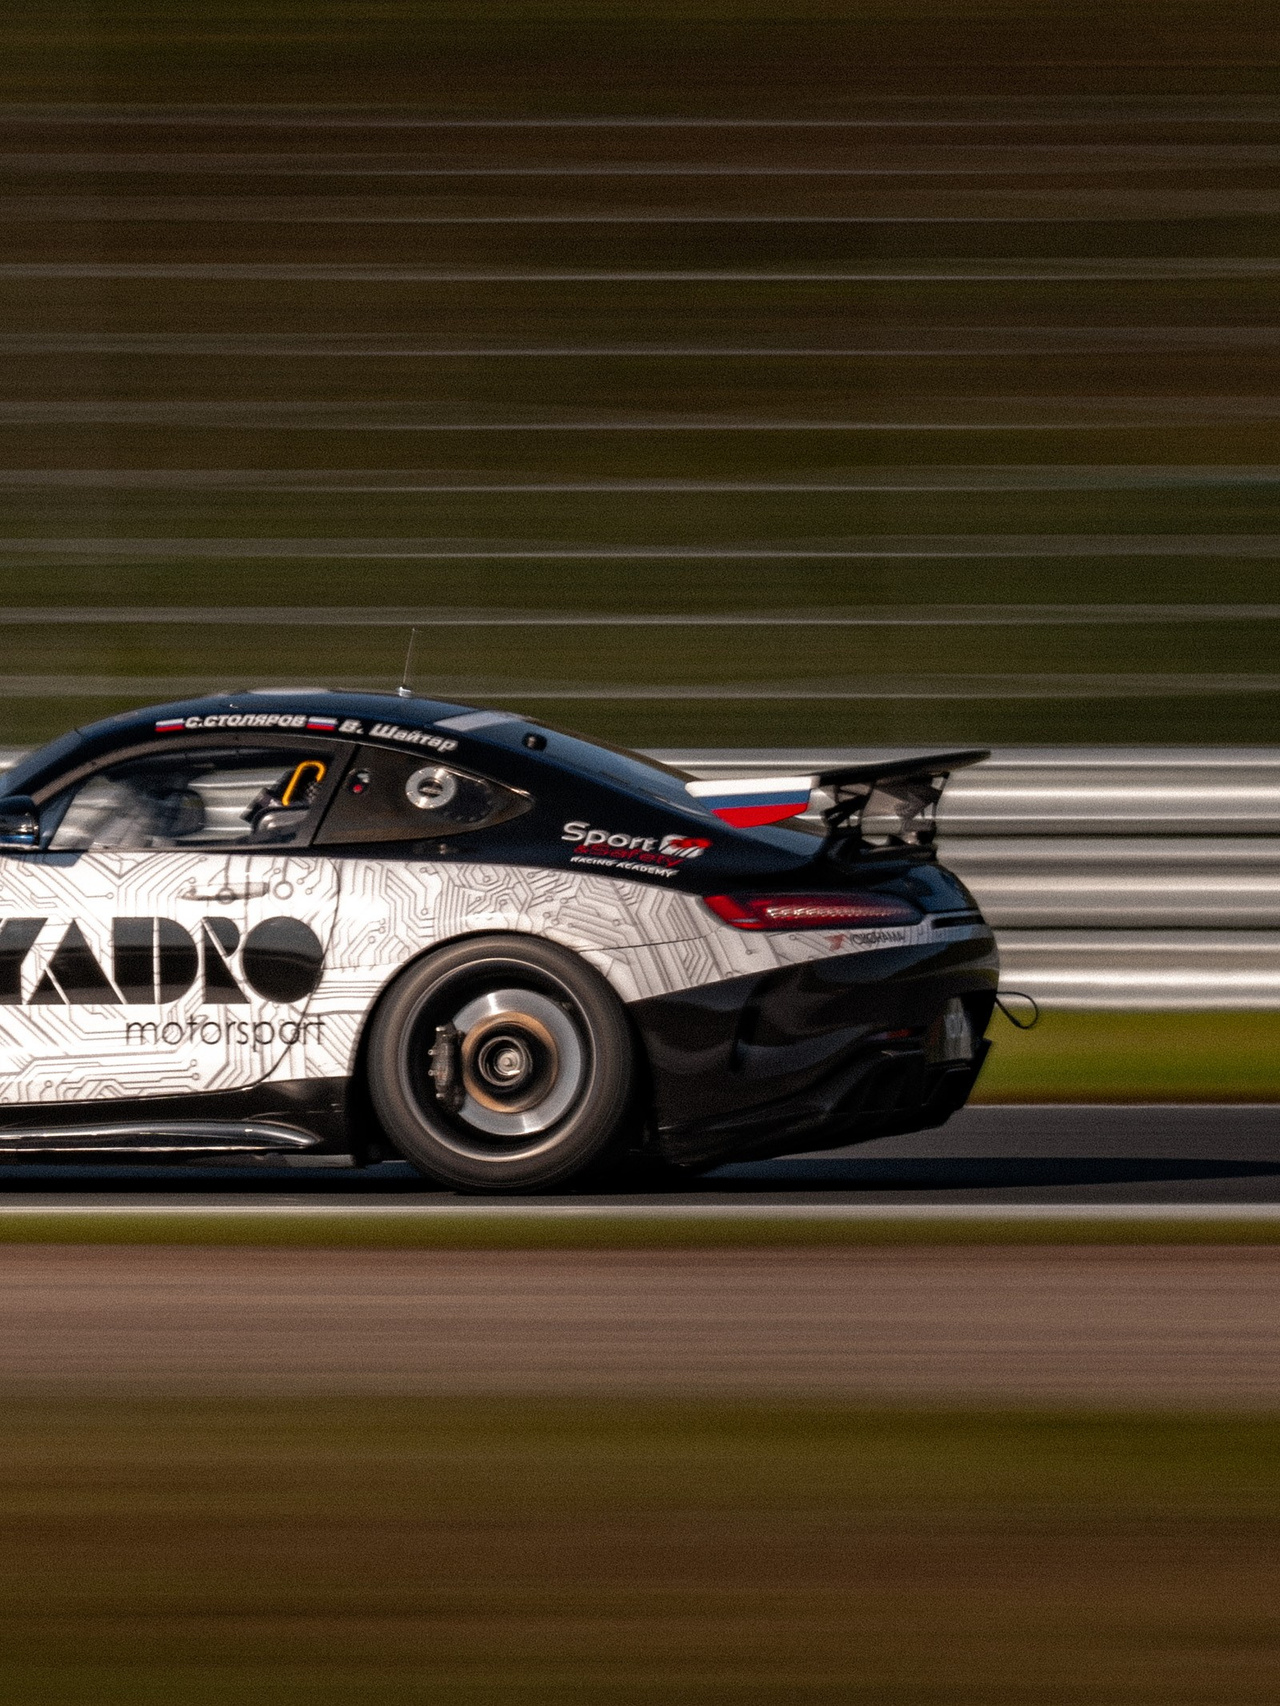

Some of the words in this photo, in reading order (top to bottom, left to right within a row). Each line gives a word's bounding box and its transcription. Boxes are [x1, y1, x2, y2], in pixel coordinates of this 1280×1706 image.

[338, 719, 364, 735] В.
[561, 820, 659, 851] Sport
[570, 855, 615, 867] RACING
[616, 861, 679, 878] ACADEMY
[125, 1015, 325, 1051] motorsport
